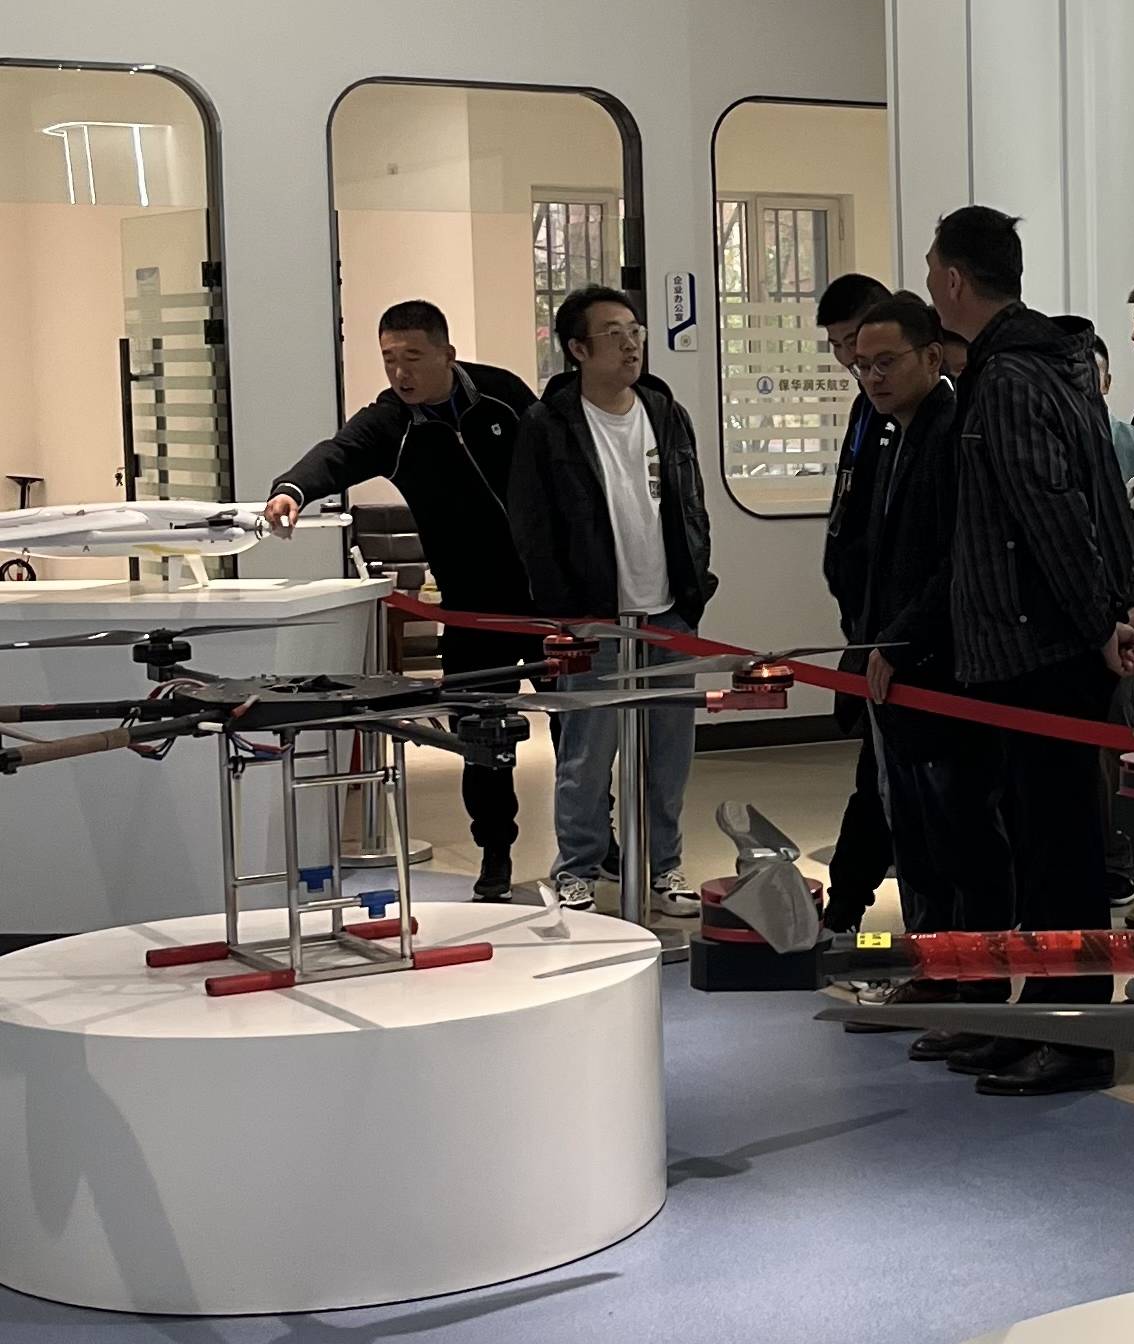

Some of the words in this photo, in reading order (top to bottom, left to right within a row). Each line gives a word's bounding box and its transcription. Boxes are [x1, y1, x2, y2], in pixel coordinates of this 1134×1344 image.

[673, 275, 684, 322] 企业办公室
